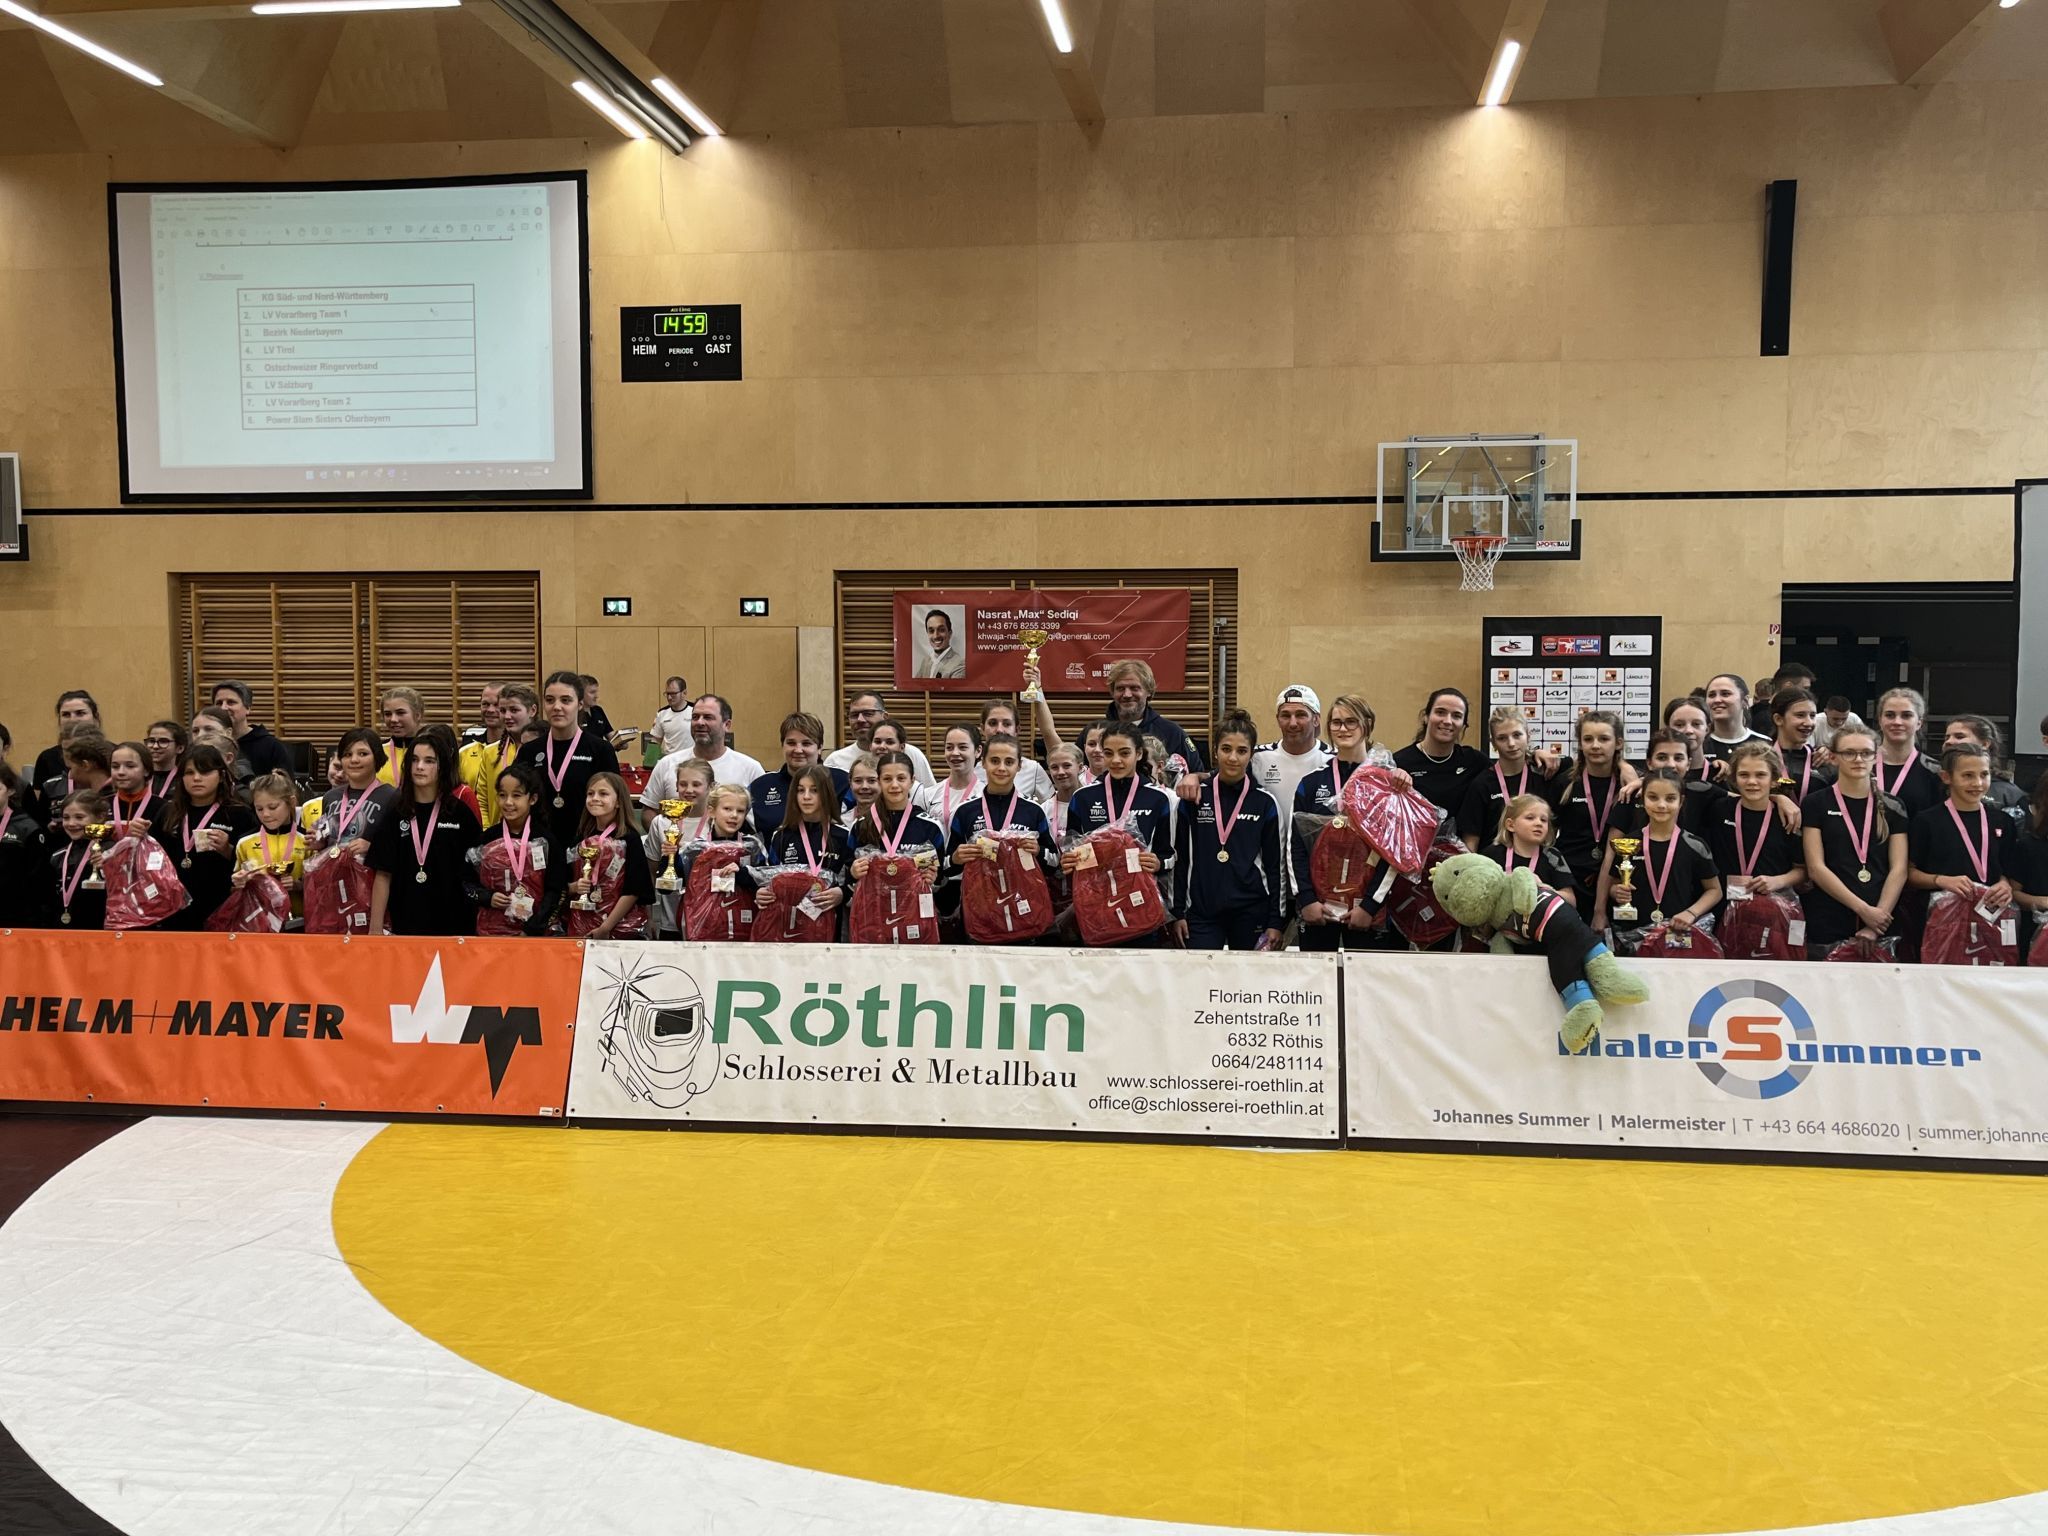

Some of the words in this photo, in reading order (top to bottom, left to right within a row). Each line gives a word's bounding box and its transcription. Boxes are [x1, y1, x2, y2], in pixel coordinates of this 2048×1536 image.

[298, 292, 313, 300] und
[314, 292, 389, 302] Nord-Württemberg
[276, 310, 317, 320] Vorarlberg
[319, 310, 341, 318] Team
[263, 328, 288, 336] Bezirk
[290, 326, 343, 338] Niederbayern
[264, 346, 275, 354] LV
[276, 346, 295, 354] Tirol
[632, 344, 656, 355] HEIM
[705, 344, 732, 354] GAST
[264, 363, 318, 372] Ostschweizer
[320, 362, 378, 372] Ringerverband
[265, 381, 276, 389] LV
[277, 380, 313, 390] Salzburg
[266, 399, 277, 407] LV
[278, 398, 320, 408] Vorarlberg
[322, 398, 344, 406] Team
[266, 415, 291, 424] Power
[315, 414, 342, 423] Sisters
[344, 414, 390, 424] Oberbayern
[977, 610, 1011, 619] Nasrat
[1048, 610, 1078, 620] Sediqi
[1209, 990, 1262, 1004] Florian
[1268, 990, 1323, 1005] Röthlin
[168, 1000, 345, 1040] MAYER
[712, 980, 1085, 1052] Röthlin
[1194, 1010, 1299, 1026] Zehentstraße
[1306, 1013, 1321, 1026] 11
[1228, 1033, 1267, 1047] 6832
[1272, 1033, 1323, 1049] Röthis
[1722, 1016, 1982, 1068] Summer
[1212, 1054, 1323, 1071] 0664/2481114
[723, 1053, 882, 1082] Schlosserei
[892, 1058, 916, 1083] &
[926, 1058, 1077, 1088] Metallbau
[1107, 1076, 1324, 1093] www.schlosserei-roethlin.at
[1088, 1096, 1324, 1116] office@schlosserei-roethlin.at
[1432, 1109, 1513, 1125] Johannes
[1518, 1112, 1590, 1127] Summer
[1611, 1115, 1726, 1132] Malermeister
[1742, 1119, 1754, 1132] T
[1760, 1119, 1791, 1134] +43
[1796, 1120, 1825, 1135] 664
[1831, 1121, 1900, 1138] 4686020
